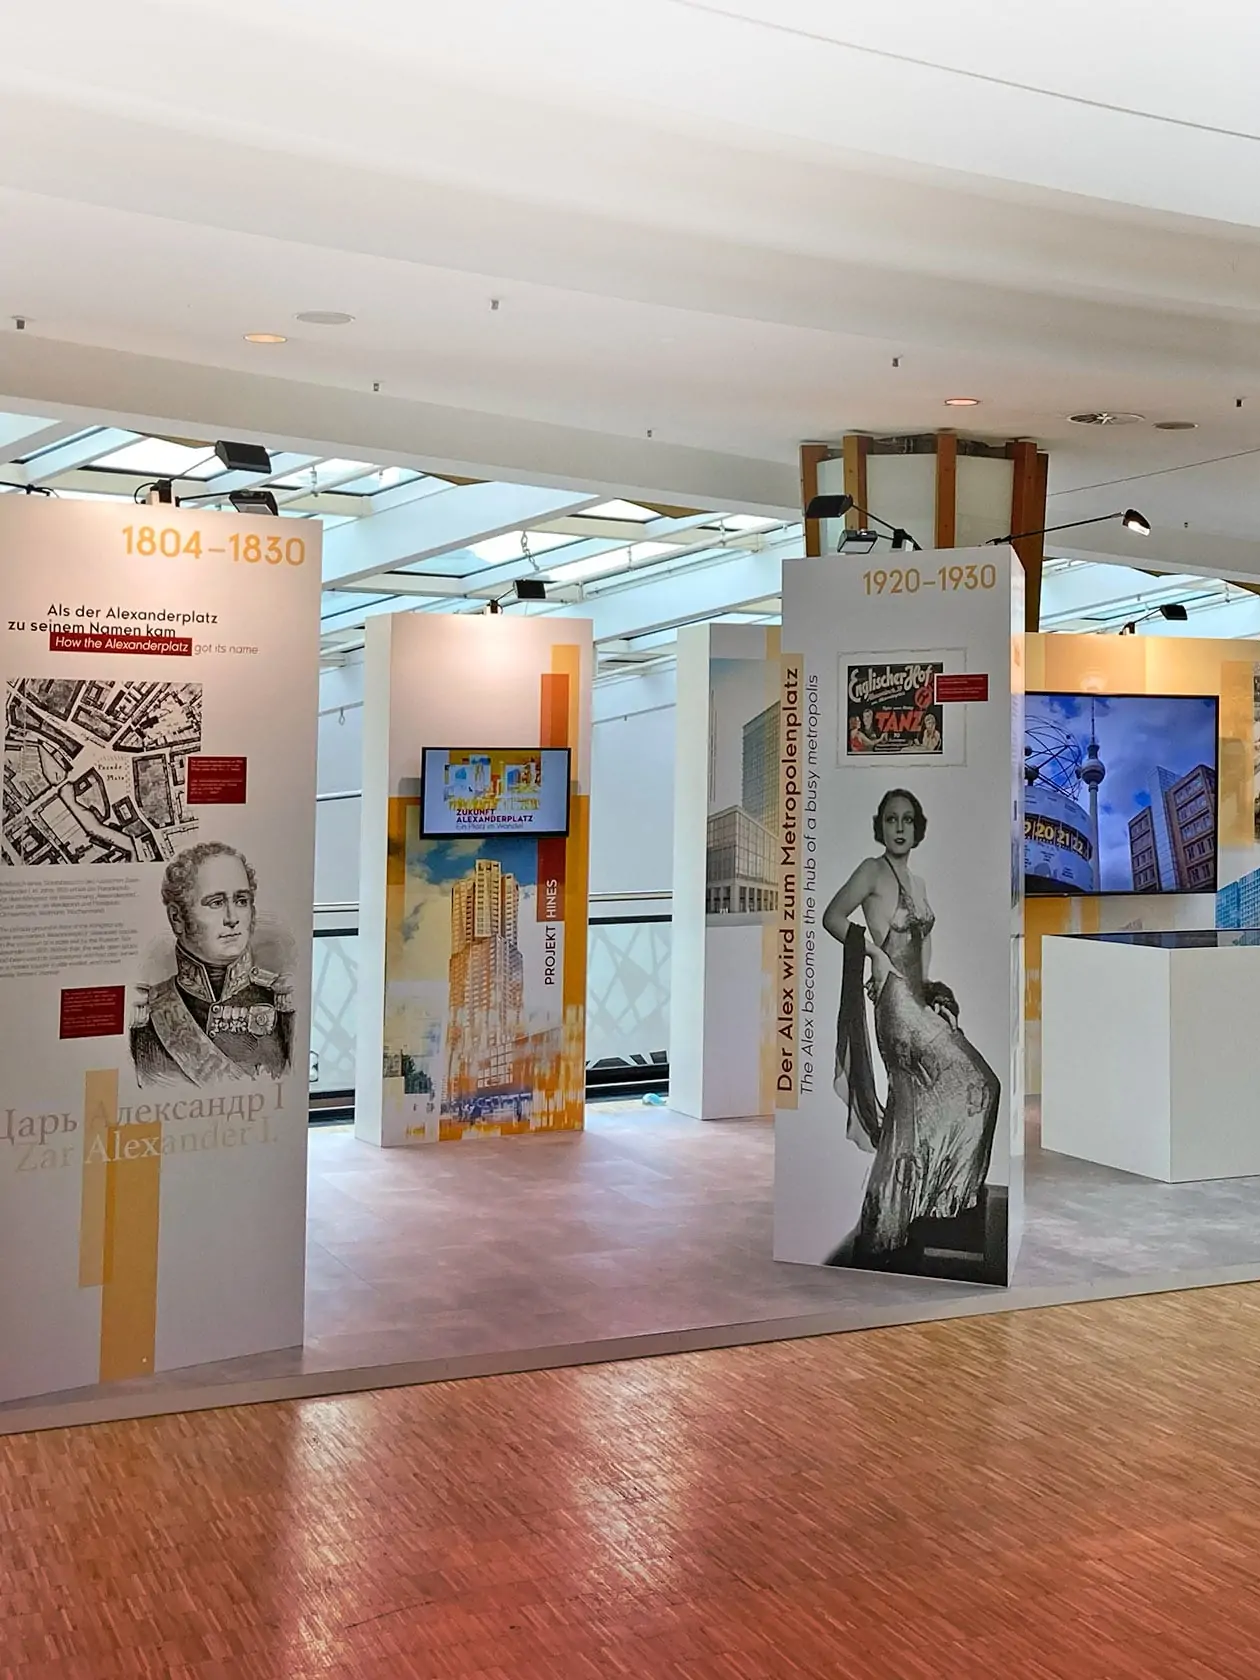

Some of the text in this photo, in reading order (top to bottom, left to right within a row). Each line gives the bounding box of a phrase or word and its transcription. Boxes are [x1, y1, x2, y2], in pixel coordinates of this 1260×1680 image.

[122, 525, 306, 567] 1804–1830
[862, 563, 997, 595] 1920–1930
[8, 619, 176, 638] zu seinem Namen kam
[47, 603, 218, 625] Als der Alexanderplatz
[55, 636, 259, 655] How the Alexanderplatz got its name
[848, 665, 907, 703] Englischer
[904, 664, 933, 690] Hof
[875, 710, 927, 733] TANZ
[456, 808, 496, 816] ZUKUNFT
[456, 815, 534, 823] ALEXANDERPLATZ
[1034, 822, 1055, 841] 20
[1056, 829, 1070, 847] 21
[777, 668, 802, 1091] Der Alex wird zum Metropolenplatz
[800, 674, 822, 1095] The Alex becomes the hub of a busy metropolis
[544, 879, 558, 985] PROJEKT HINES
[90, 1092, 265, 1129] Александр
[15, 1144, 76, 1173] Zar
[84, 1124, 256, 1165] Alexander
